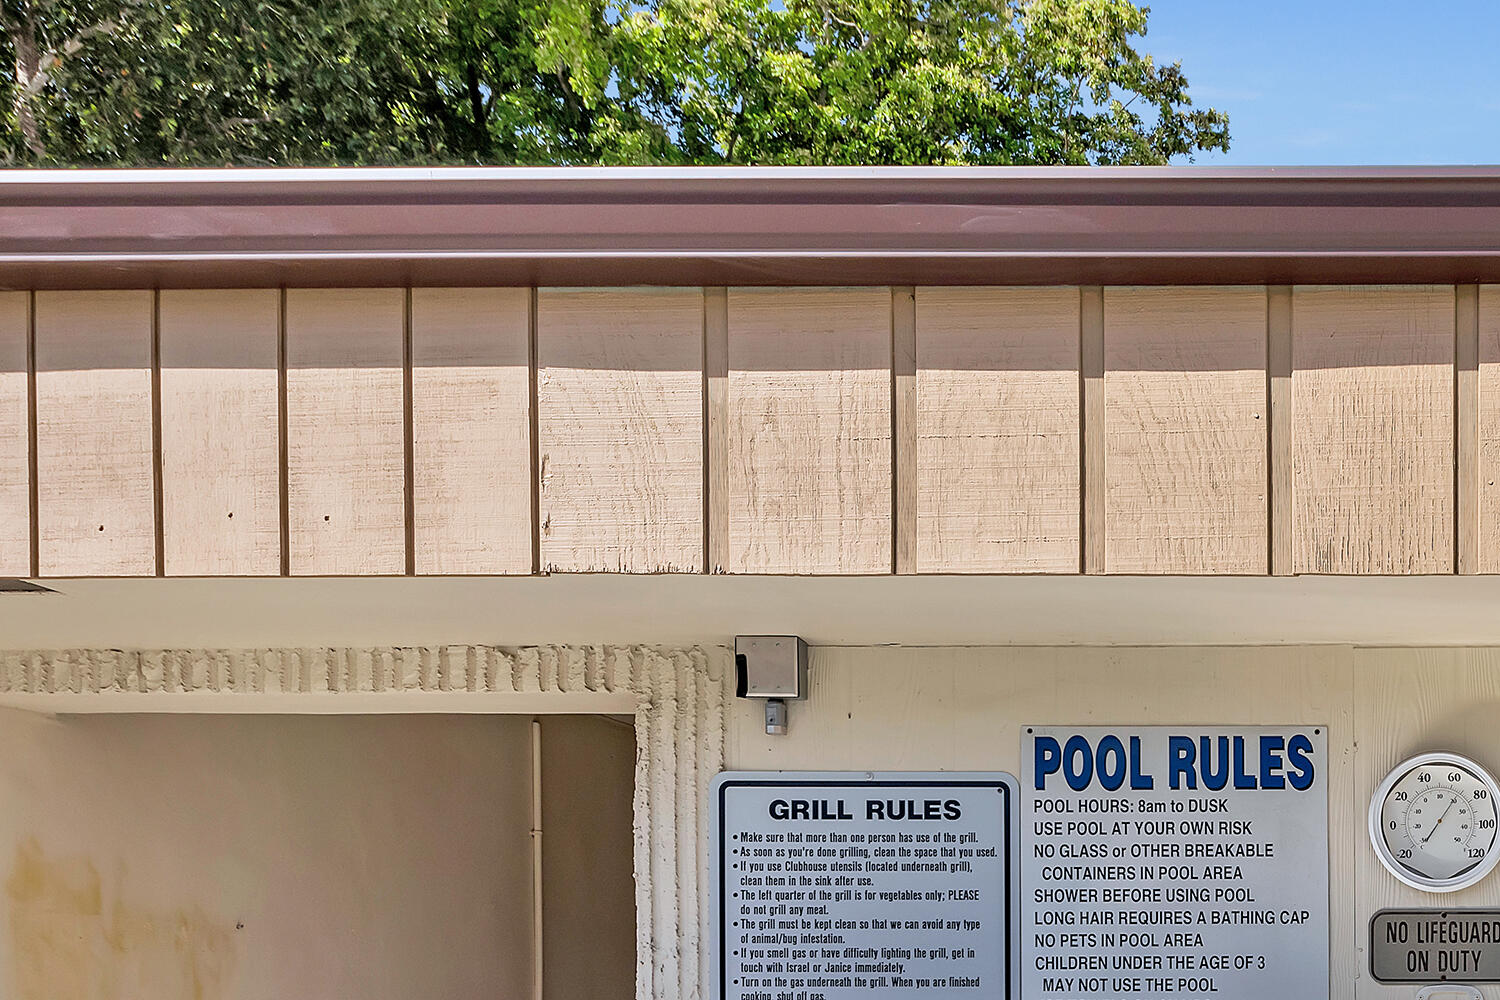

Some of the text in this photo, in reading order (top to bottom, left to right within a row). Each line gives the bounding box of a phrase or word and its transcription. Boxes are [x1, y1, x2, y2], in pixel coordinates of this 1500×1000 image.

[1034, 734, 1314, 791] POOL RULES
[1418, 772, 1431, 782] 40
[1448, 772, 1461, 782] 60
[1395, 792, 1408, 801] 20
[1474, 790, 1486, 799] 80
[769, 800, 961, 820] GRILL RULES
[1034, 799, 1228, 813] POOL HOURS: 8am to DUSK
[1035, 821, 1252, 835] USE POOL AT YOUR OWN RISK
[1390, 820, 1396, 830] 0
[1479, 819, 1494, 829] 100
[741, 832, 762, 842] Make
[787, 832, 802, 842] that
[830, 832, 847, 842] than
[868, 835, 895, 844] person
[899, 832, 913, 842] has
[933, 832, 940, 842] of
[944, 832, 956, 842] the
[960, 832, 978, 844] grill.
[740, 846, 750, 856] As
[788, 847, 814, 858] you're
[817, 846, 836, 857] done
[840, 847, 870, 858] grilling,
[874, 847, 895, 857] clean
[899, 847, 911, 857] the
[914, 849, 937, 858] space
[941, 847, 956, 857] that
[959, 849, 972, 858] you
[976, 847, 997, 857] used.
[1035, 844, 1273, 858] NO GLASS or OTHER BREAKABLE
[1397, 849, 1412, 858] -20
[1468, 848, 1485, 857] 120
[741, 861, 746, 871] If
[750, 863, 764, 873] you
[785, 861, 827, 871] Clubhouse
[831, 861, 862, 871] utensils
[866, 861, 898, 872] (located
[902, 861, 947, 871] underneath
[951, 861, 972, 873] grill),
[740, 875, 762, 886] clean
[766, 876, 785, 886] them
[789, 876, 796, 886] in
[800, 876, 812, 886] the
[815, 876, 832, 886] sink
[835, 876, 854, 886] after
[1034, 888, 1254, 902] SHOWER BEFORE USING POOL
[1035, 911, 1309, 925] LONG HAIR REQUIRES A BATHING CAP
[1387, 922, 1408, 943] NO
[1036, 956, 1265, 970] CHILDREN UNDER THE AGE OF 3
[1407, 950, 1482, 972] ON DUTY
[1043, 978, 1218, 992] MAY NOT USE THE POOL
